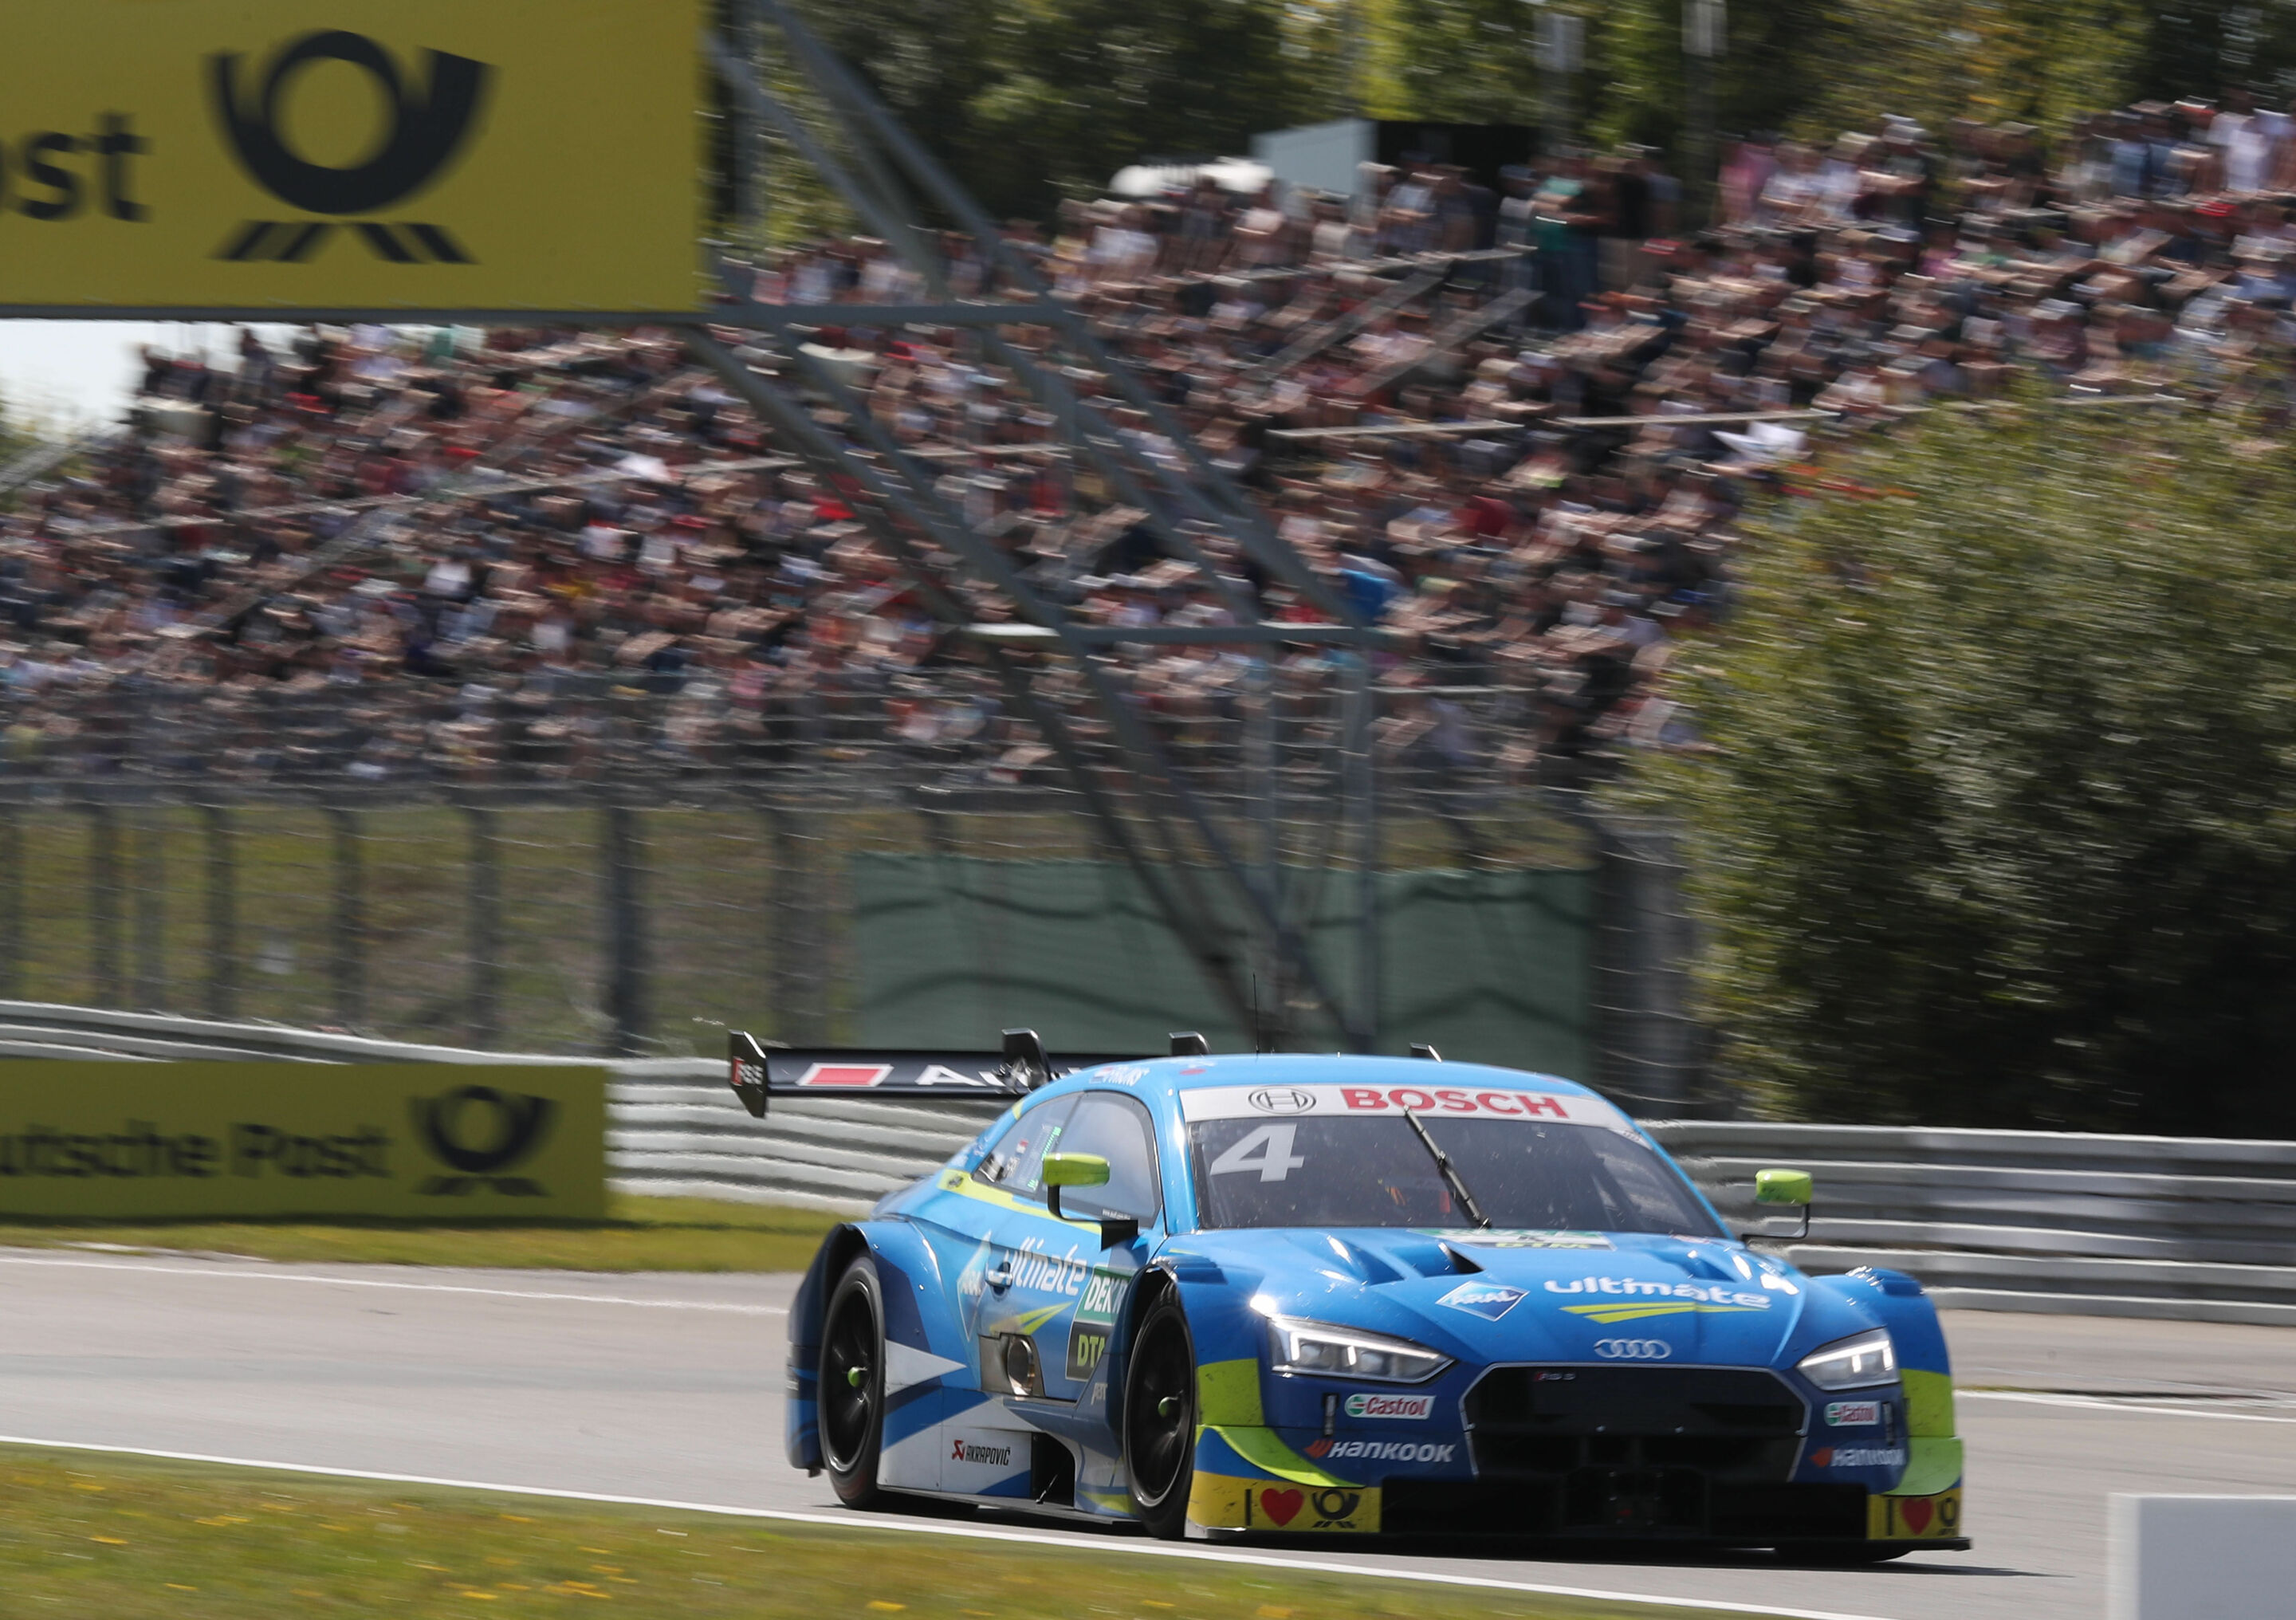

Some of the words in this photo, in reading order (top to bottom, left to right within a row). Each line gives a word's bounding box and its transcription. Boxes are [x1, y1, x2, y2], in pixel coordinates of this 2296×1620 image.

[0, 110, 154, 223] st
[1339, 1088, 1570, 1118] BOSCH
[229, 1120, 394, 1179] Post
[1209, 1123, 1304, 1182] 4
[1543, 1276, 1772, 1310] ultimate
[1366, 1397, 1429, 1416] Castrol
